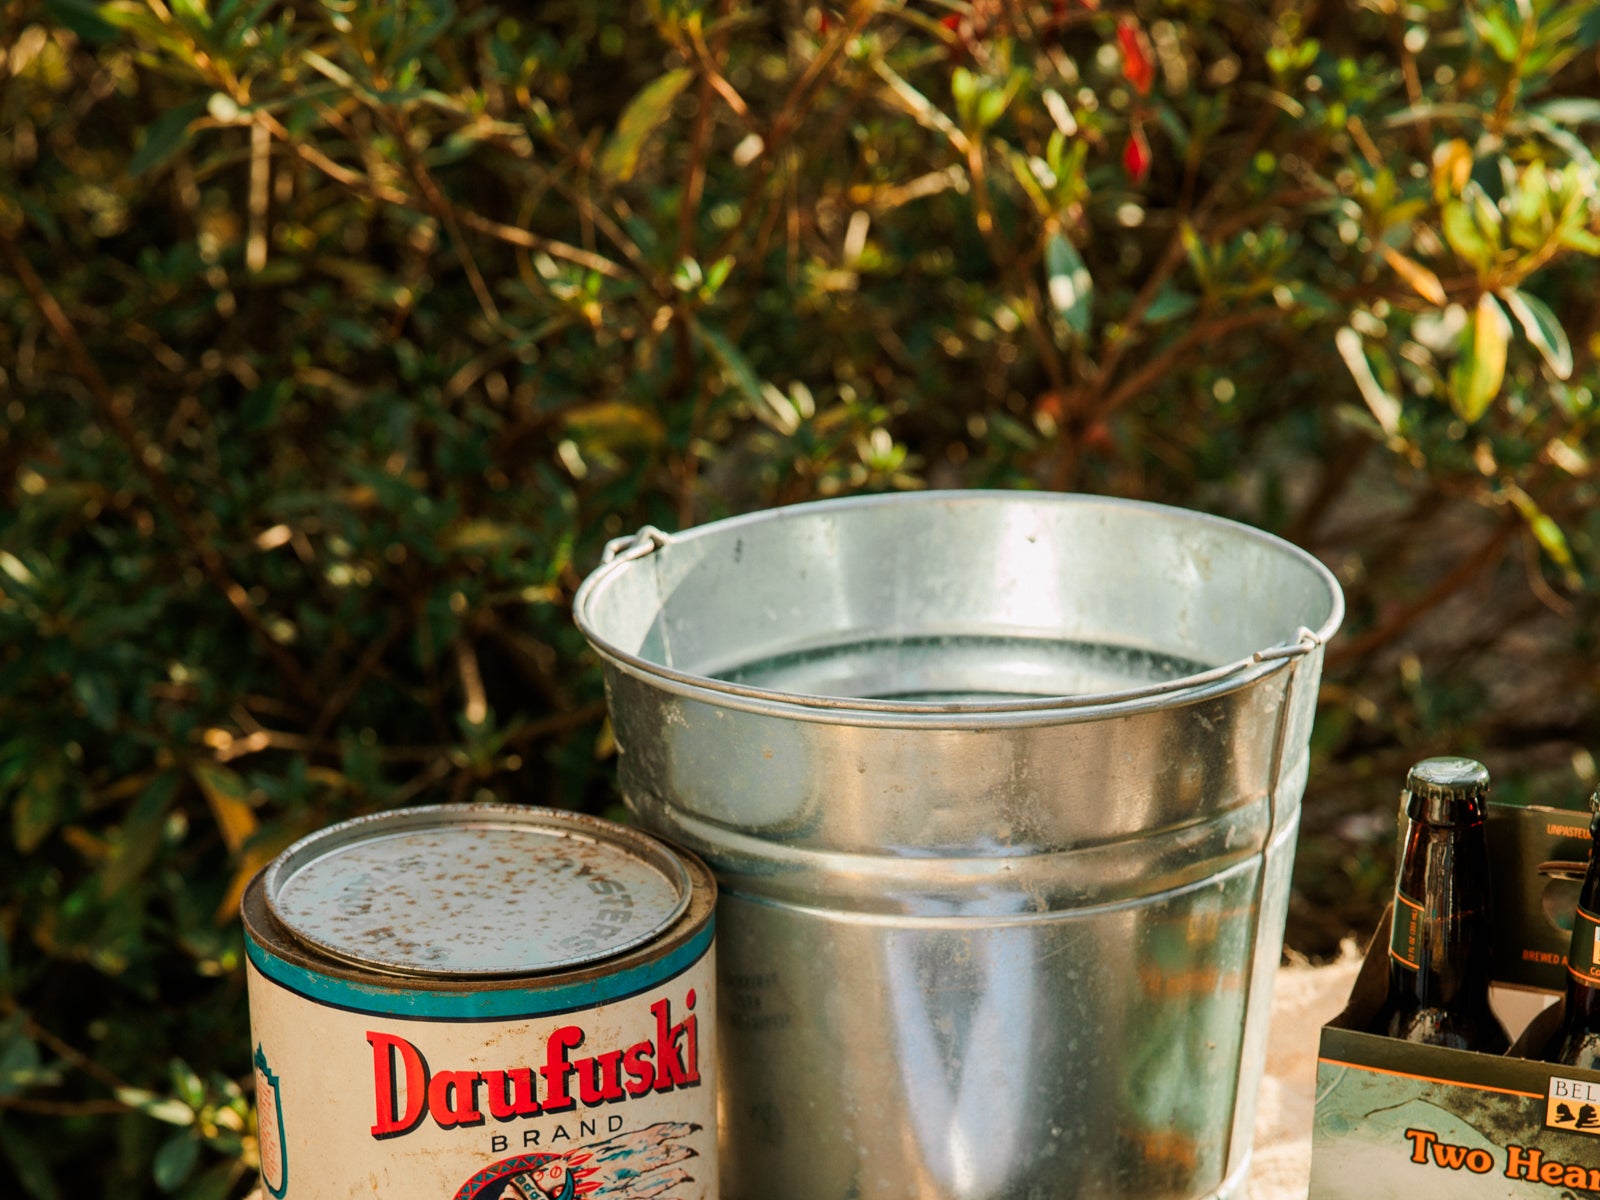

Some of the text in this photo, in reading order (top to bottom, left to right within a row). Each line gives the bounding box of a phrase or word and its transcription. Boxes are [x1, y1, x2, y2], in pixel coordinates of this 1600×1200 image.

[1521, 949, 1560, 965] BREWED
[366, 988, 702, 1140] Daufuski
[491, 1114, 624, 1153] BRAND
[1405, 1127, 1495, 1175] Two
